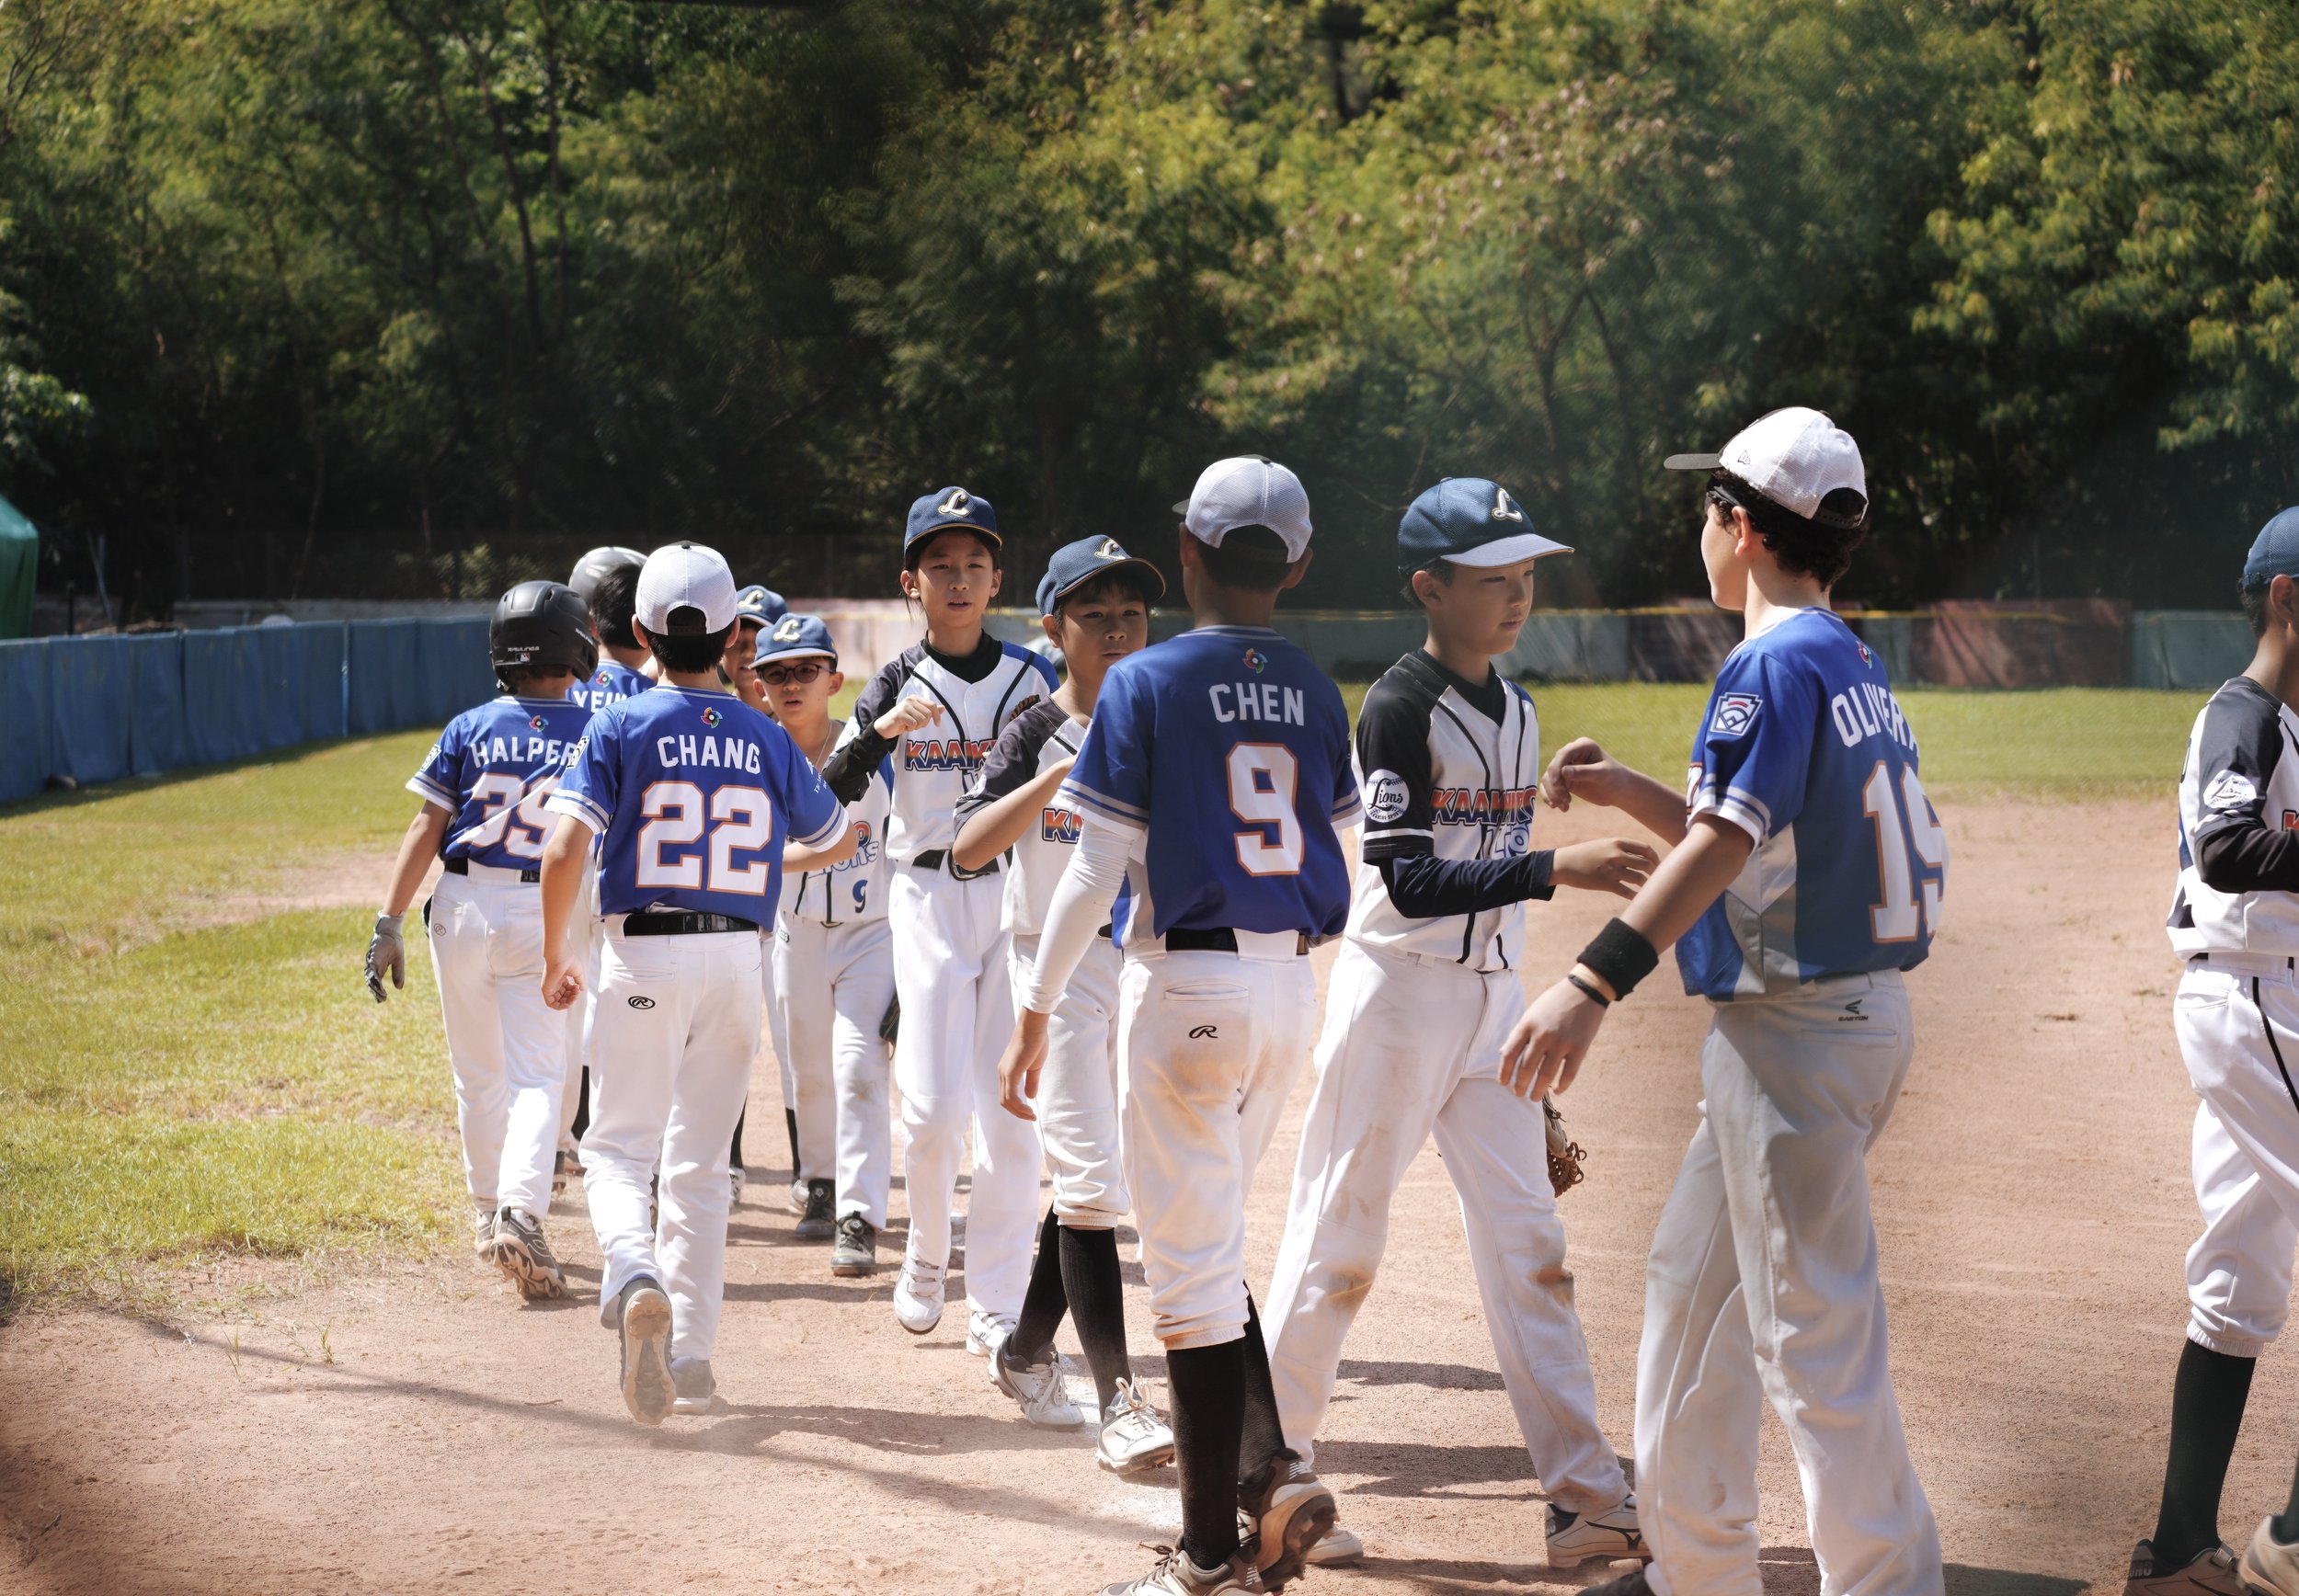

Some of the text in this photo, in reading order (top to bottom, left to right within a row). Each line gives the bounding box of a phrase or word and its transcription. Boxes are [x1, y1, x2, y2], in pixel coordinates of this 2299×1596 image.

[939, 490, 970, 517] L
[1492, 488, 1523, 522] L
[1094, 539, 1126, 560] L
[738, 590, 764, 610] L
[773, 620, 800, 643] L
[1208, 682, 1305, 726] CHEN
[658, 735, 761, 774] CHANG
[1226, 742, 1305, 877] 9
[1367, 778, 1403, 811] Lions
[467, 772, 562, 860] 39
[635, 781, 772, 895] 22
[1862, 760, 1949, 943] 19
[852, 880, 868, 913] 9
